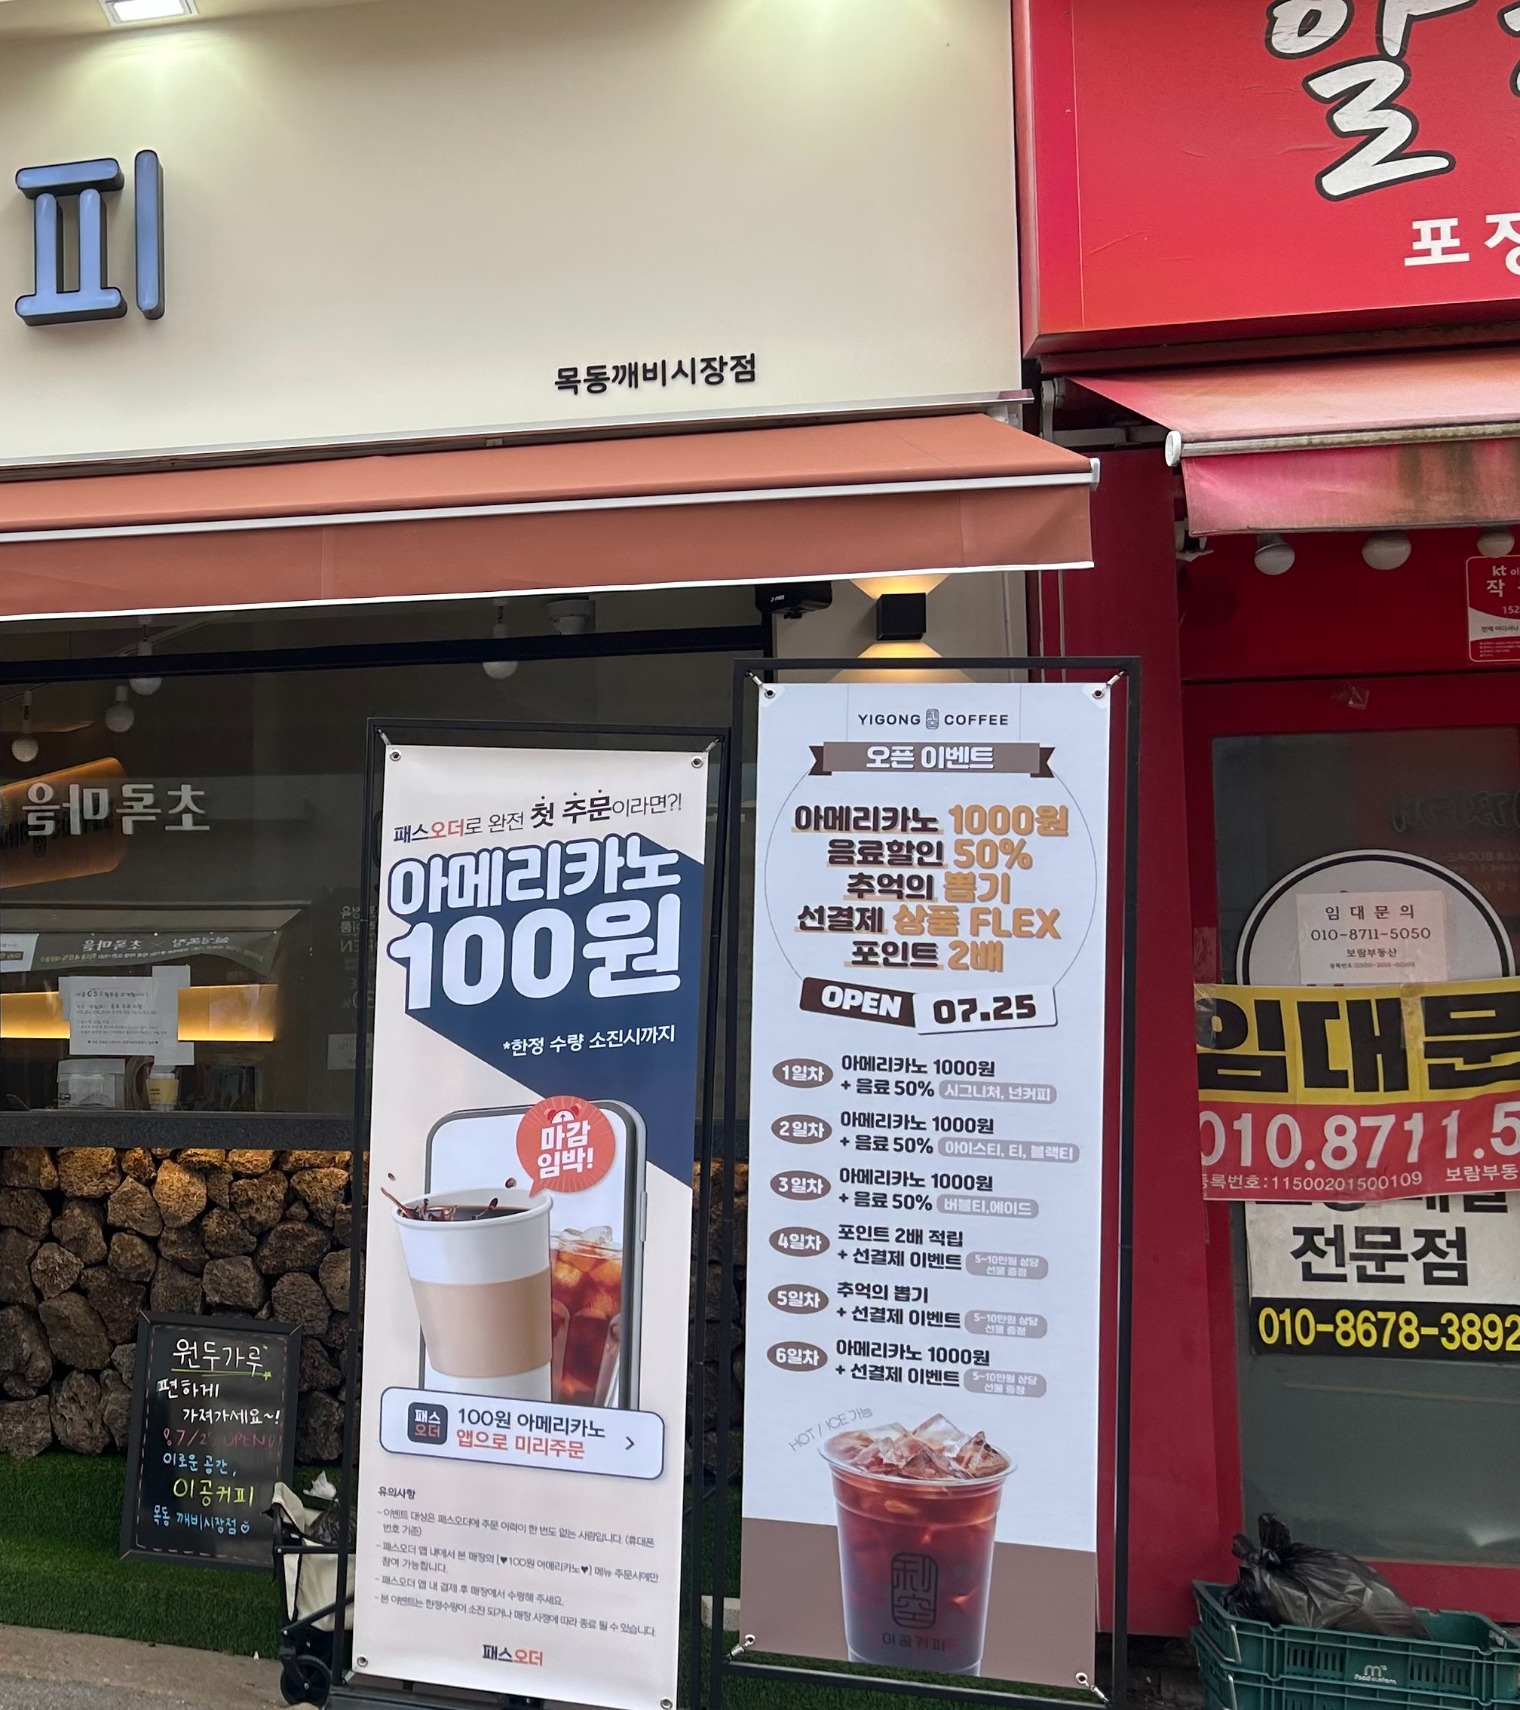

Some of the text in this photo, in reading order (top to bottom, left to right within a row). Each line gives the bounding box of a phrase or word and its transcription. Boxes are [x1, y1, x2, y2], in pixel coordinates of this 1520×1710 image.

[554, 353, 756, 395] 목동깨비시장점
[857, 713, 1009, 726] YIGONG COFFEE
[865, 745, 994, 770] 오픈 이벤트
[392, 790, 682, 844] 패스오더로 완전 첫 주문이라면?!
[794, 804, 1069, 836] 아메리카노 1000원
[828, 838, 1033, 870] 음료할인 50%
[389, 834, 682, 916] 아메리카노
[847, 872, 1011, 903] 추억의 뽑기
[797, 905, 1062, 939] 선결제 상품 FLEX
[1310, 927, 1432, 941] 010-8711-5050
[389, 893, 682, 1011] 100원
[852, 940, 1004, 972] 포인트 2배
[1346, 948, 1398, 958] 보람부동산
[820, 985, 1037, 1025] OPEN 07.25
[549, 1032, 585, 1053] 수량
[588, 1024, 675, 1050] 소진시까지
[781, 1054, 996, 1083] 1일차 아메리카노 1000원
[856, 1078, 1051, 1102] 음료 50% 시그니처, 넌커피
[539, 1120, 592, 1150] 마감
[779, 1111, 995, 1139] 2일차 아메리카노 1000원
[855, 1134, 890, 1152] 음료
[893, 1137, 934, 1154] 50%
[944, 1140, 1005, 1158] 아이스티,
[536, 1148, 594, 1179] 임박!
[778, 1167, 994, 1195] 3일차 아메리카노 1000원
[854, 1191, 933, 1211] 음료 50%
[777, 1224, 964, 1251] 4일차 포인트 2배 적립
[853, 1248, 905, 1267] 선결제
[909, 1251, 963, 1270] 이벤트
[1289, 1226, 1469, 1287] 전문점
[777, 1281, 929, 1308] 5일차 추억의 뽑기
[851, 1305, 904, 1325] 선결제
[908, 1309, 961, 1329] 이벤트
[1257, 1306, 1520, 1353] 010-8678-3892
[775, 1339, 991, 1367] 6일차 아메리카노 1000원
[157, 1377, 220, 1400] 편하게
[850, 1363, 903, 1383] 선결제
[907, 1367, 960, 1387] 이벤트
[182, 1408, 281, 1425] 가져가세요~!
[414, 1409, 441, 1425] 패스
[457, 1407, 607, 1439] 100원 아메리카노
[788, 1405, 874, 1452] HOT ICE 가능
[414, 1424, 441, 1439] 오더
[456, 1428, 586, 1460] 앱으로 미리주문
[163, 1452, 237, 1477] 이로운 공간,
[173, 1478, 255, 1507] 이공커피
[377, 1486, 416, 1500] 유의사항
[153, 1504, 238, 1536] 목동 깨비시장점
[383, 1508, 409, 1519] 이벤트
[481, 1519, 499, 1531] 주문
[482, 1643, 544, 1667] 패스오더
